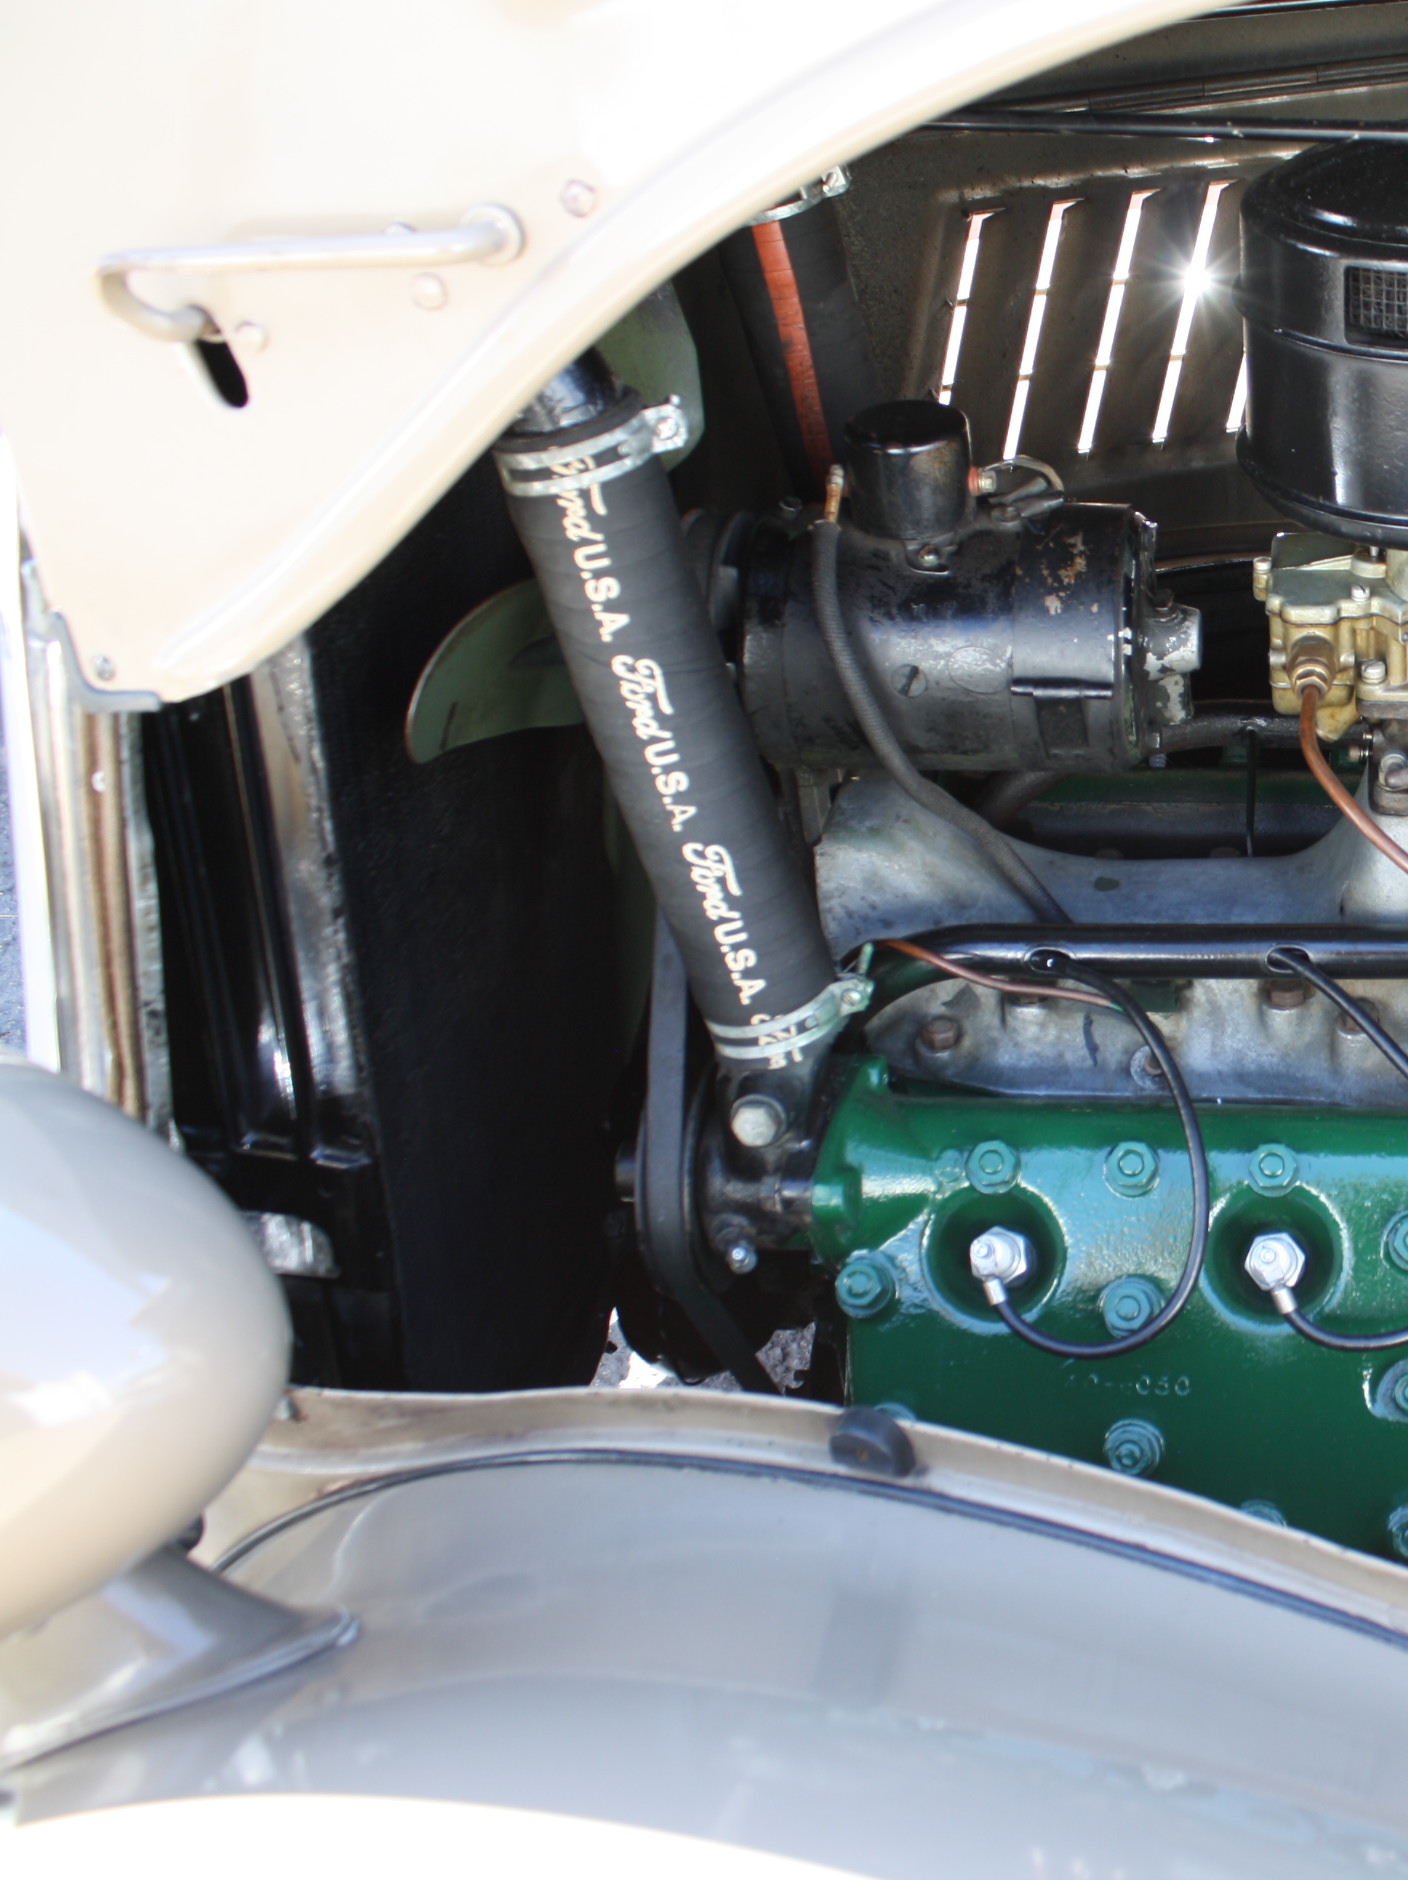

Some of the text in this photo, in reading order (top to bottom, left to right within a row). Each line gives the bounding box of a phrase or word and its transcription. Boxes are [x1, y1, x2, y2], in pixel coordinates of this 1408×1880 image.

[573, 542, 631, 643] U.S.A.
[611, 654, 698, 832] Ford U.S.A.
[682, 841, 767, 1005] Ford U.S.A.
